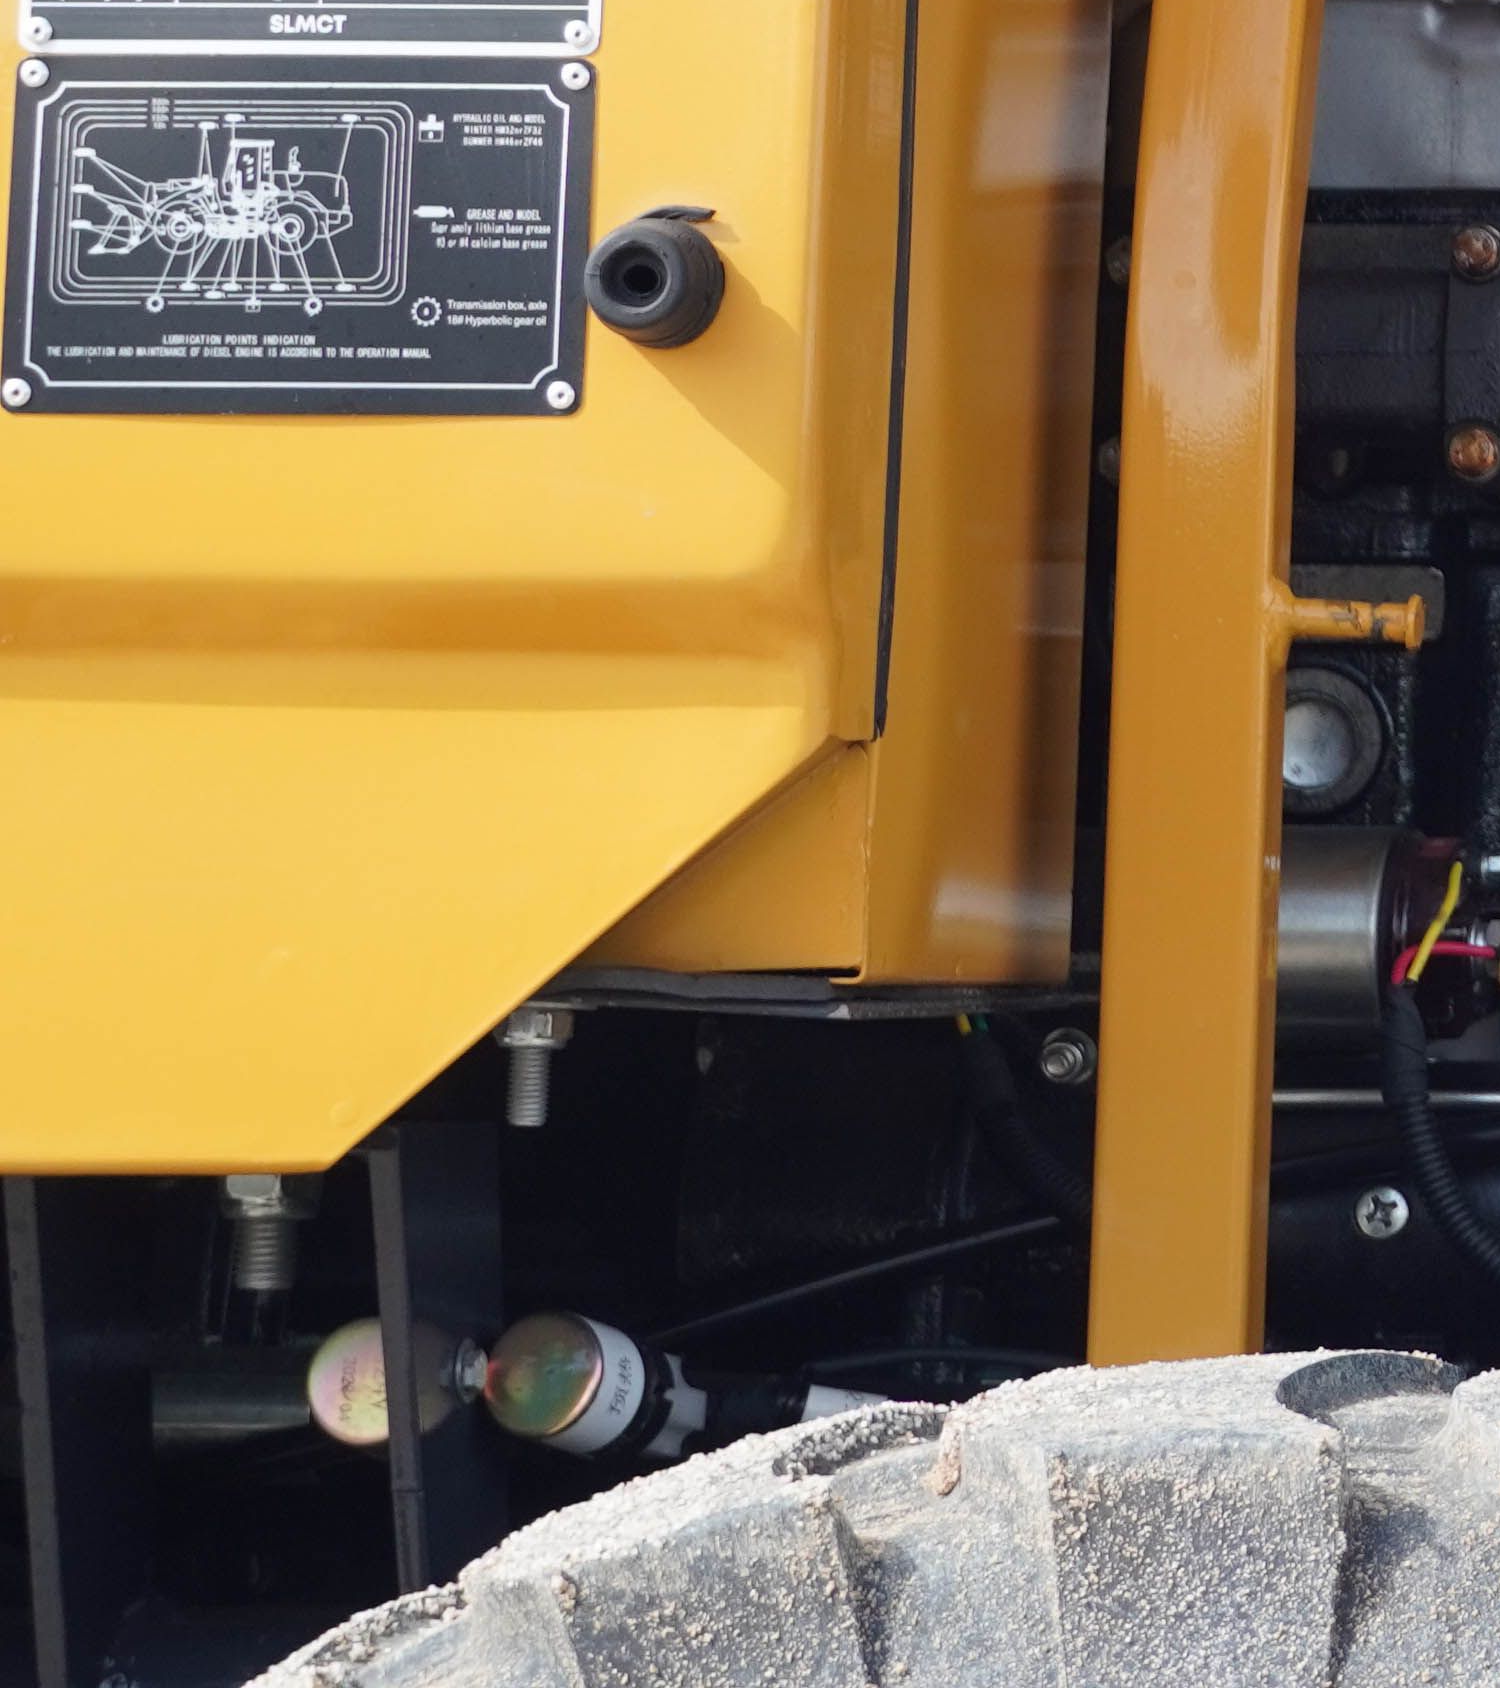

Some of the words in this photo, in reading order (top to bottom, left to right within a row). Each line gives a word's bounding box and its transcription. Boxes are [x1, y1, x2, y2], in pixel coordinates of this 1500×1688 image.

[269, 13, 347, 34] SLMCT
[467, 209, 496, 220] GREASE
[498, 209, 513, 220] AND
[447, 299, 506, 310] Transmission
[465, 315, 512, 327] Hyperbolic
[514, 317, 533, 328] gear
[162, 334, 221, 345] LUBRICATION
[225, 334, 258, 345] POINTS
[263, 335, 316, 346] INDICATION
[47, 346, 62, 357] THE
[118, 346, 133, 357] AND
[136, 346, 187, 358] MAINTENANCE
[190, 347, 200, 357] OF
[203, 347, 232, 357] DIESEL
[235, 347, 263, 358] ENGINE
[280, 347, 322, 358] ACCORDING
[326, 347, 336, 358] TO
[340, 347, 354, 358] THE
[357, 347, 399, 359] OPERATION
